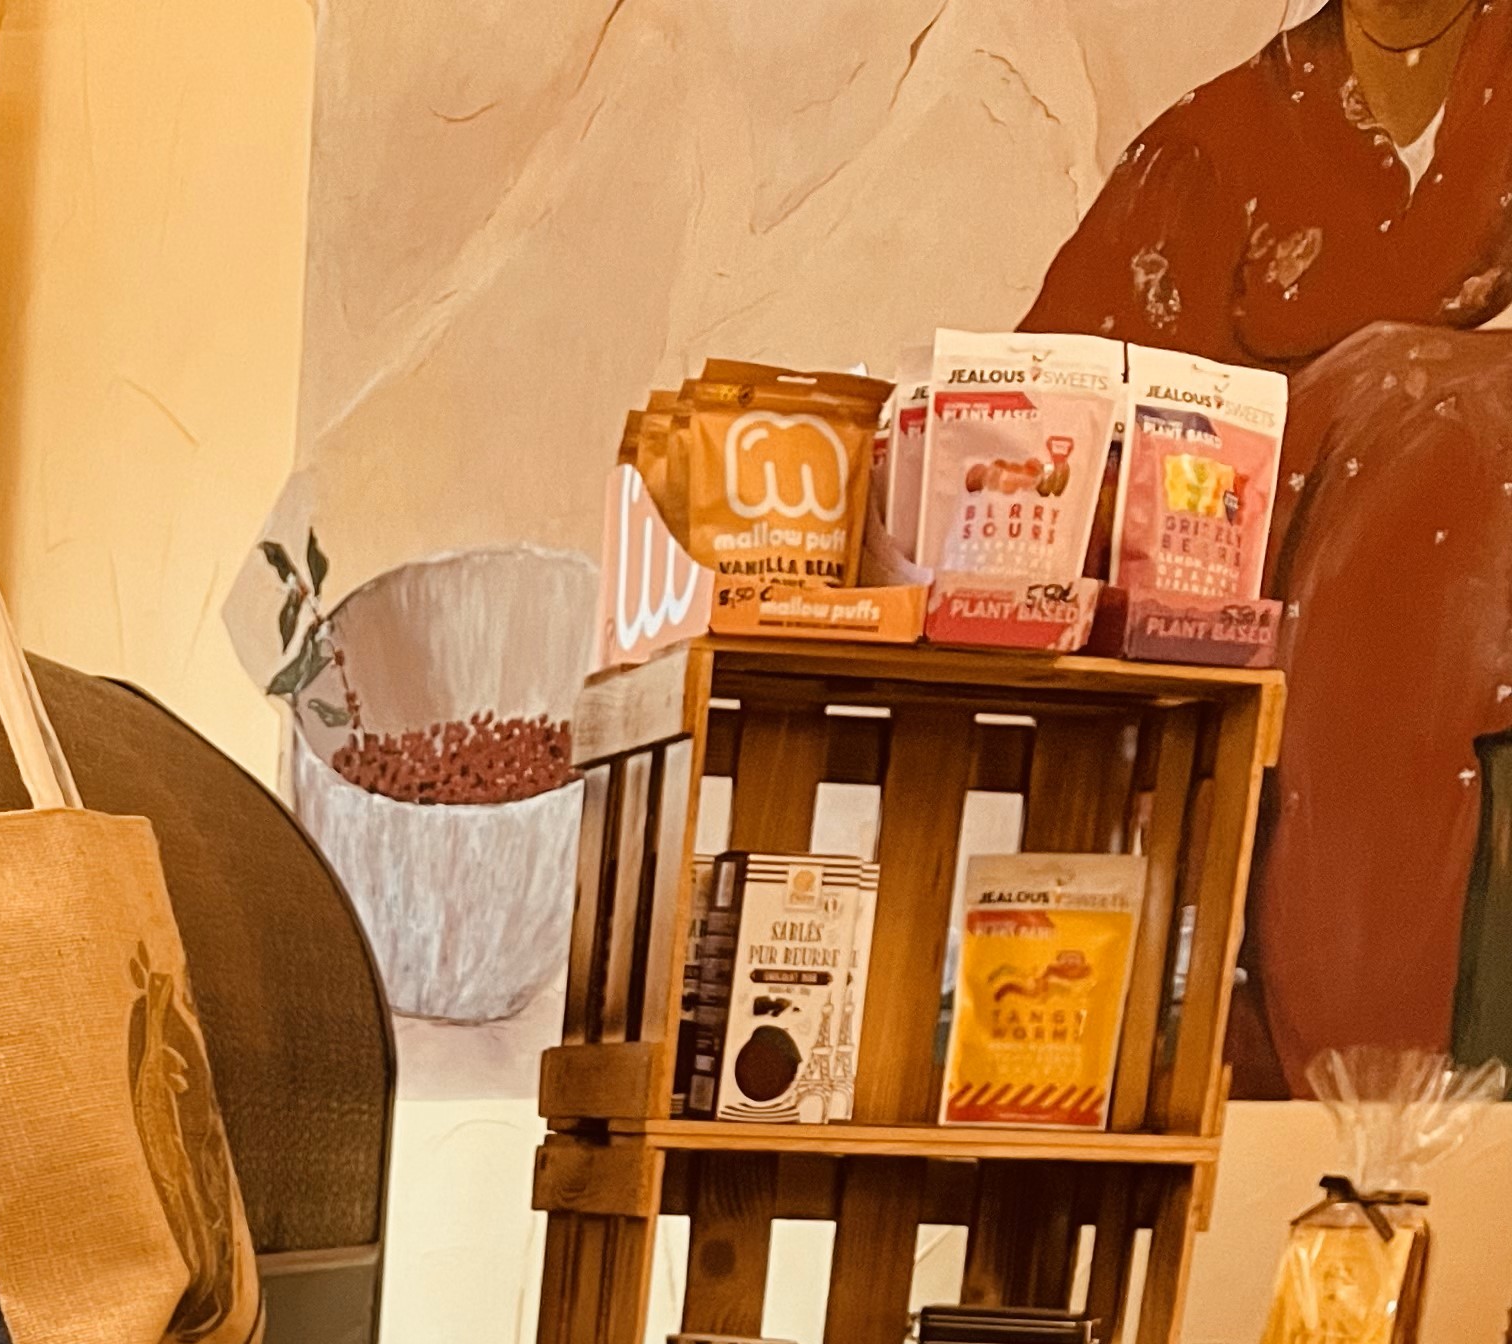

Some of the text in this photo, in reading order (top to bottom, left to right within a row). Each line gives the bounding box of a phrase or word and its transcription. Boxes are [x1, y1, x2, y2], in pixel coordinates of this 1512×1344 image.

[948, 369, 1109, 391] JEALOUS SWEETS
[1146, 386, 1211, 408] JEALOUS
[714, 521, 802, 550] mallow
[719, 557, 845, 577] VANILLA BEAN
[760, 597, 880, 622] mallow puffs
[951, 599, 1080, 623] PLANT BASED
[1147, 616, 1207, 640] PLANT
[1211, 622, 1272, 645] BASED
[979, 891, 1050, 904] JEALOUS
[770, 920, 825, 942] SABLÉS
[748, 945, 840, 968] PUR BEURRE
